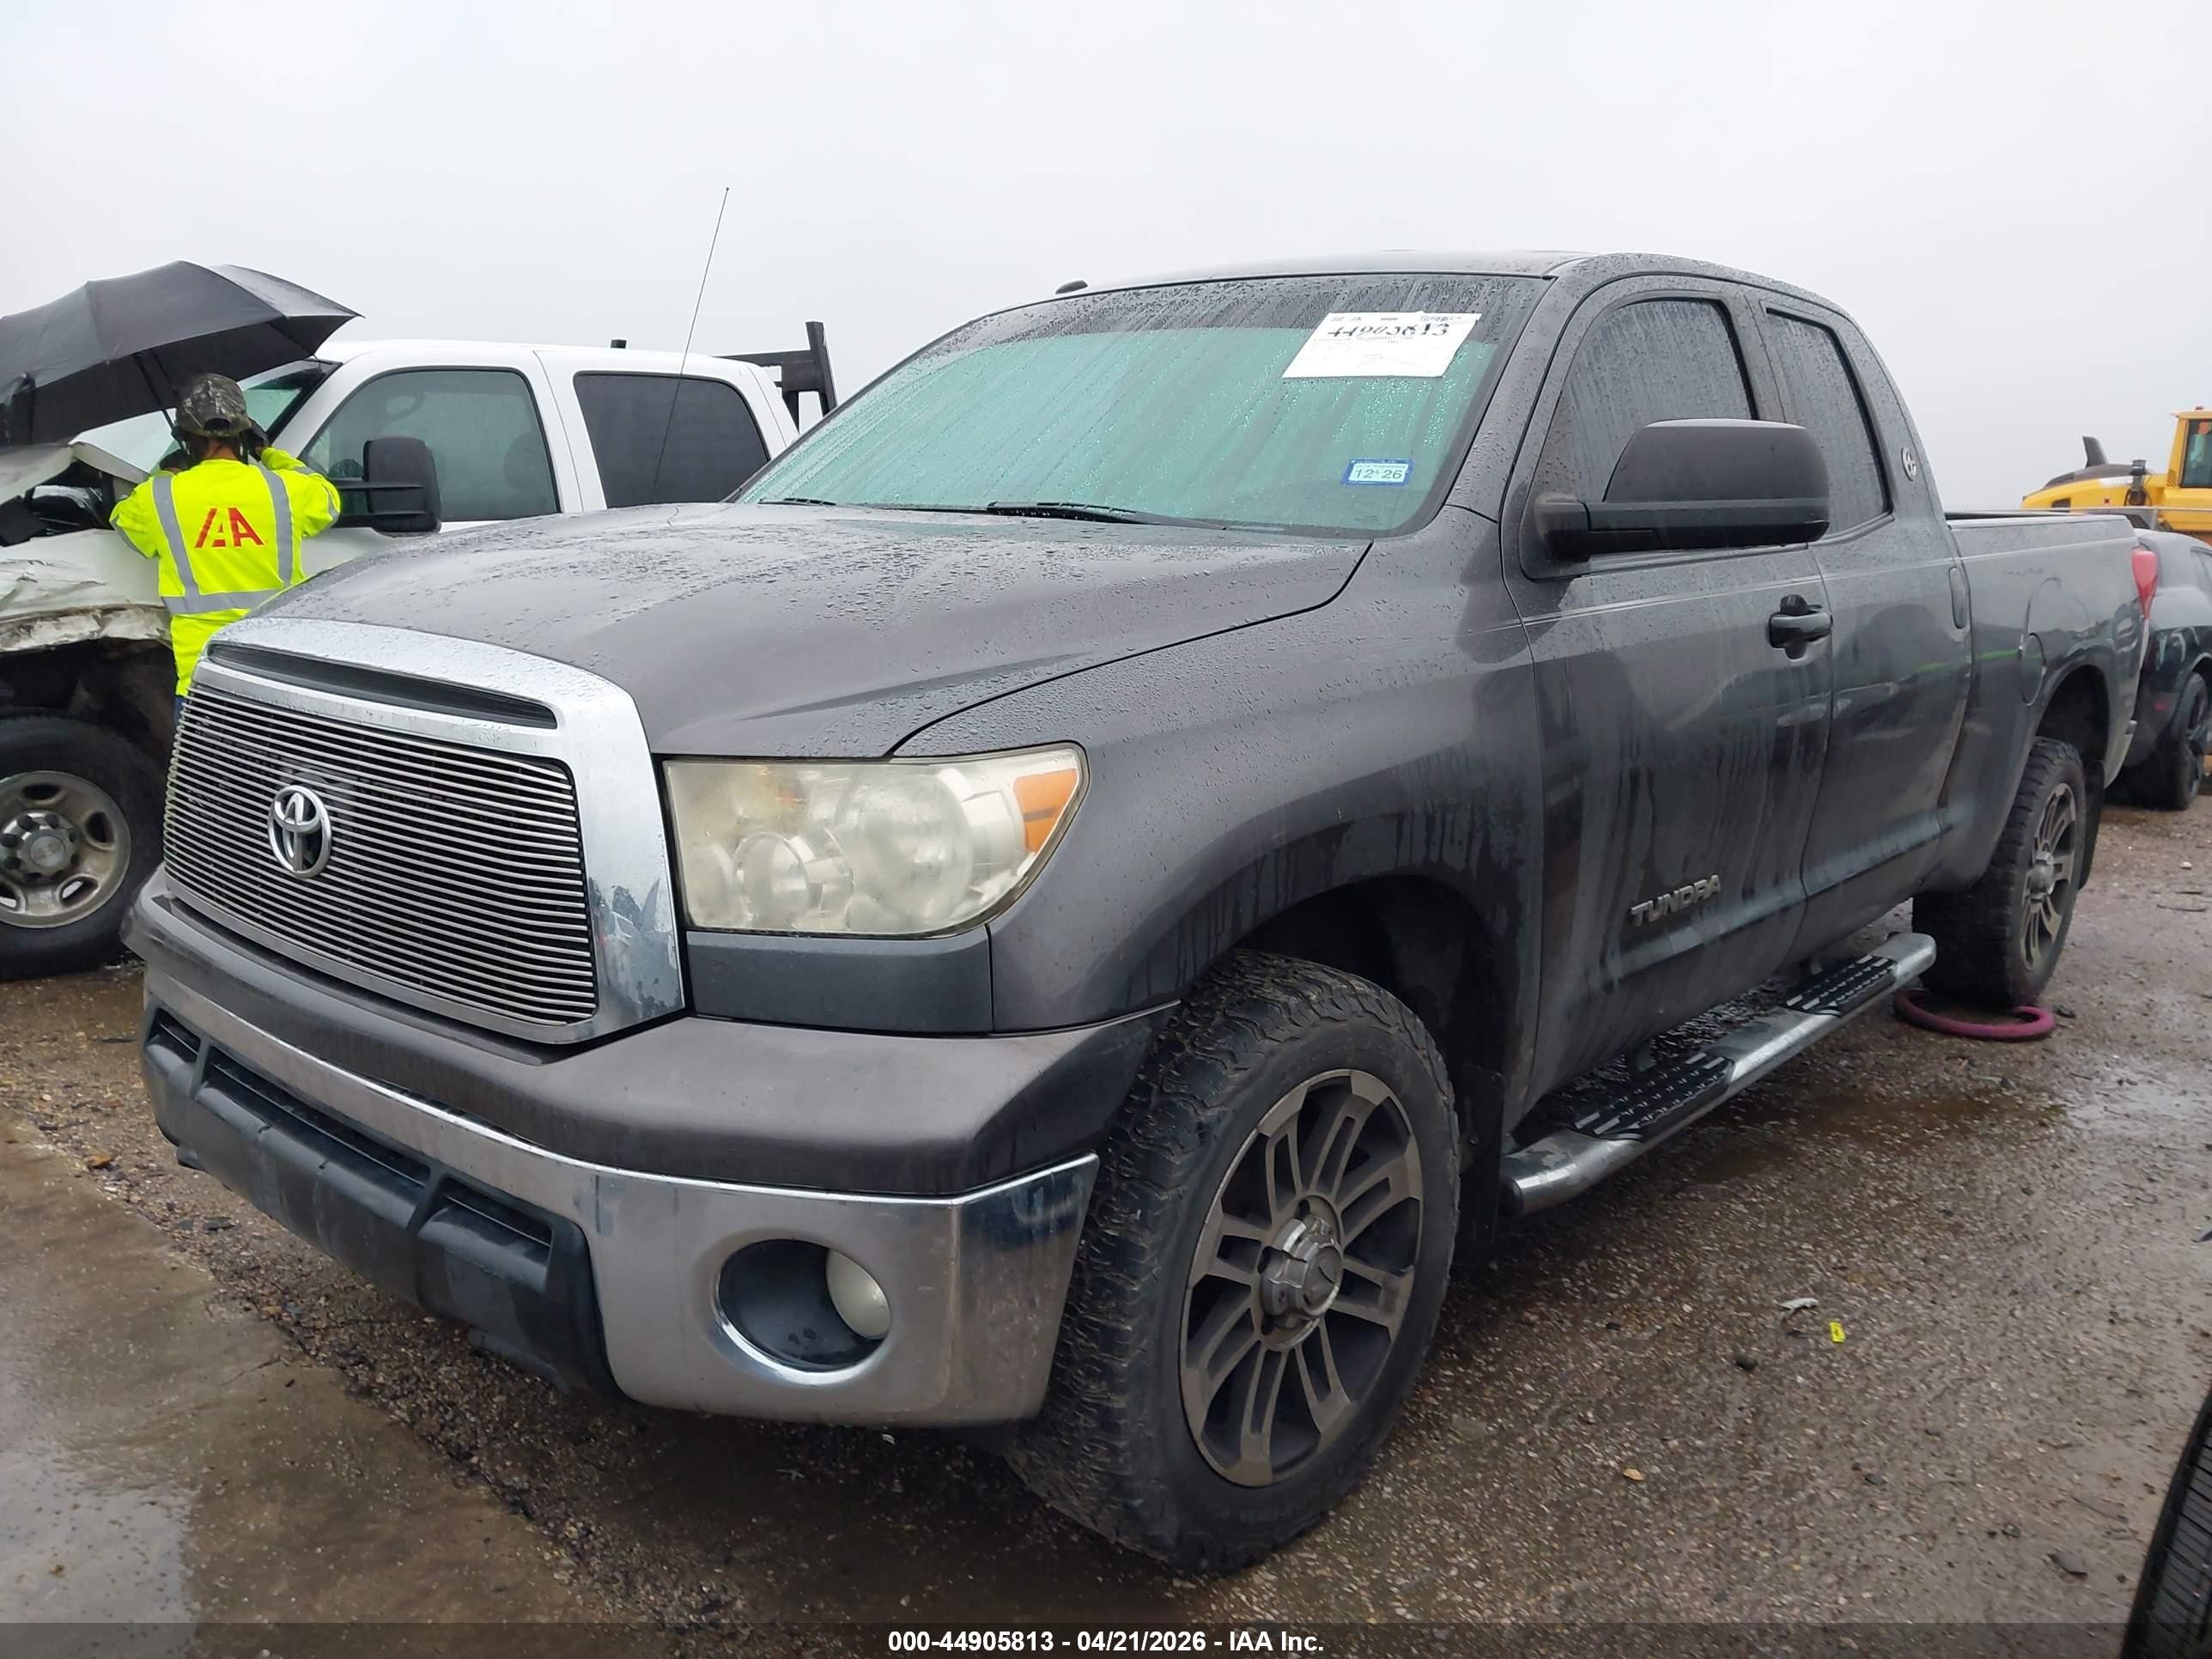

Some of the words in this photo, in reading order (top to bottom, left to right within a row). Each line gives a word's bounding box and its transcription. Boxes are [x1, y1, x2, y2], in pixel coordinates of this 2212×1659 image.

[1355, 469, 1374, 479] 12
[1382, 469, 1402, 479] 26
[1630, 873, 1723, 927] TUNDRA
